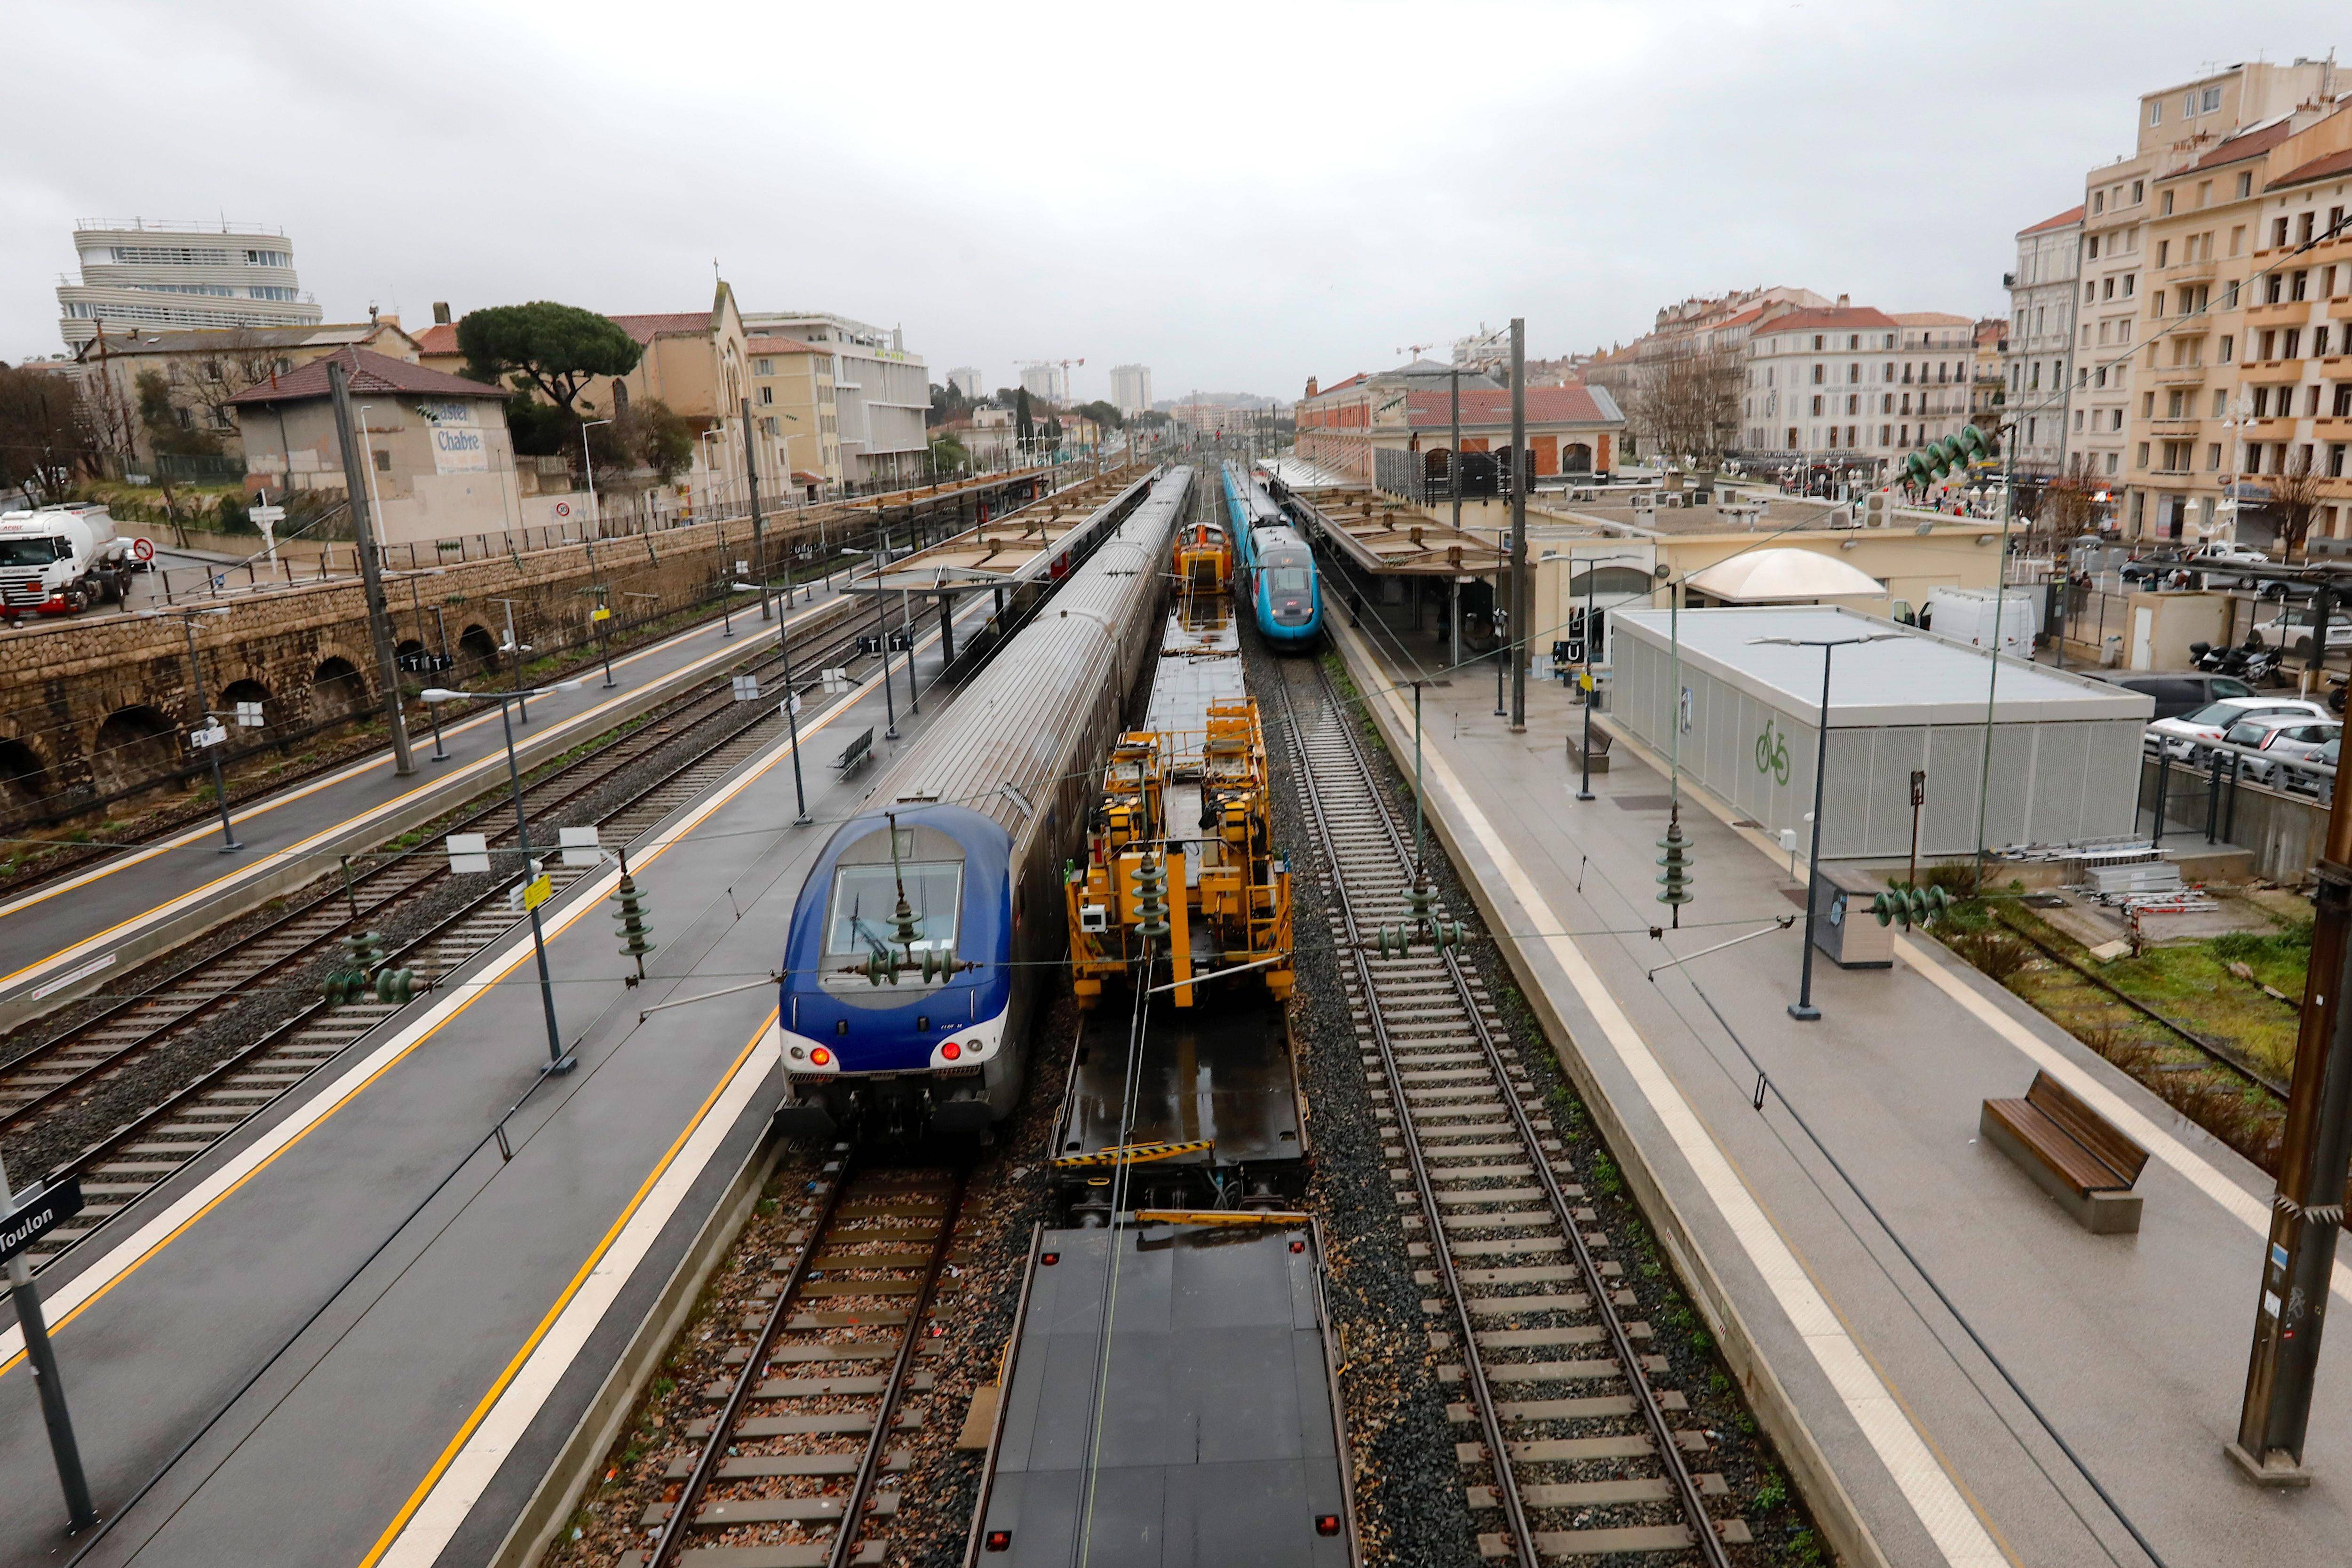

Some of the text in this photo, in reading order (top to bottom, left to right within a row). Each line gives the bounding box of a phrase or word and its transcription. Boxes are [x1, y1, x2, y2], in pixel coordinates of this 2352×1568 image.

[438, 430, 480, 451] Chabre
[868, 640, 877, 652] T
[893, 638, 901, 651] T
[1568, 645, 1580, 661] U
[410, 659, 418, 671] T
[433, 658, 441, 670] T
[0, 1208, 53, 1252] Toulon
